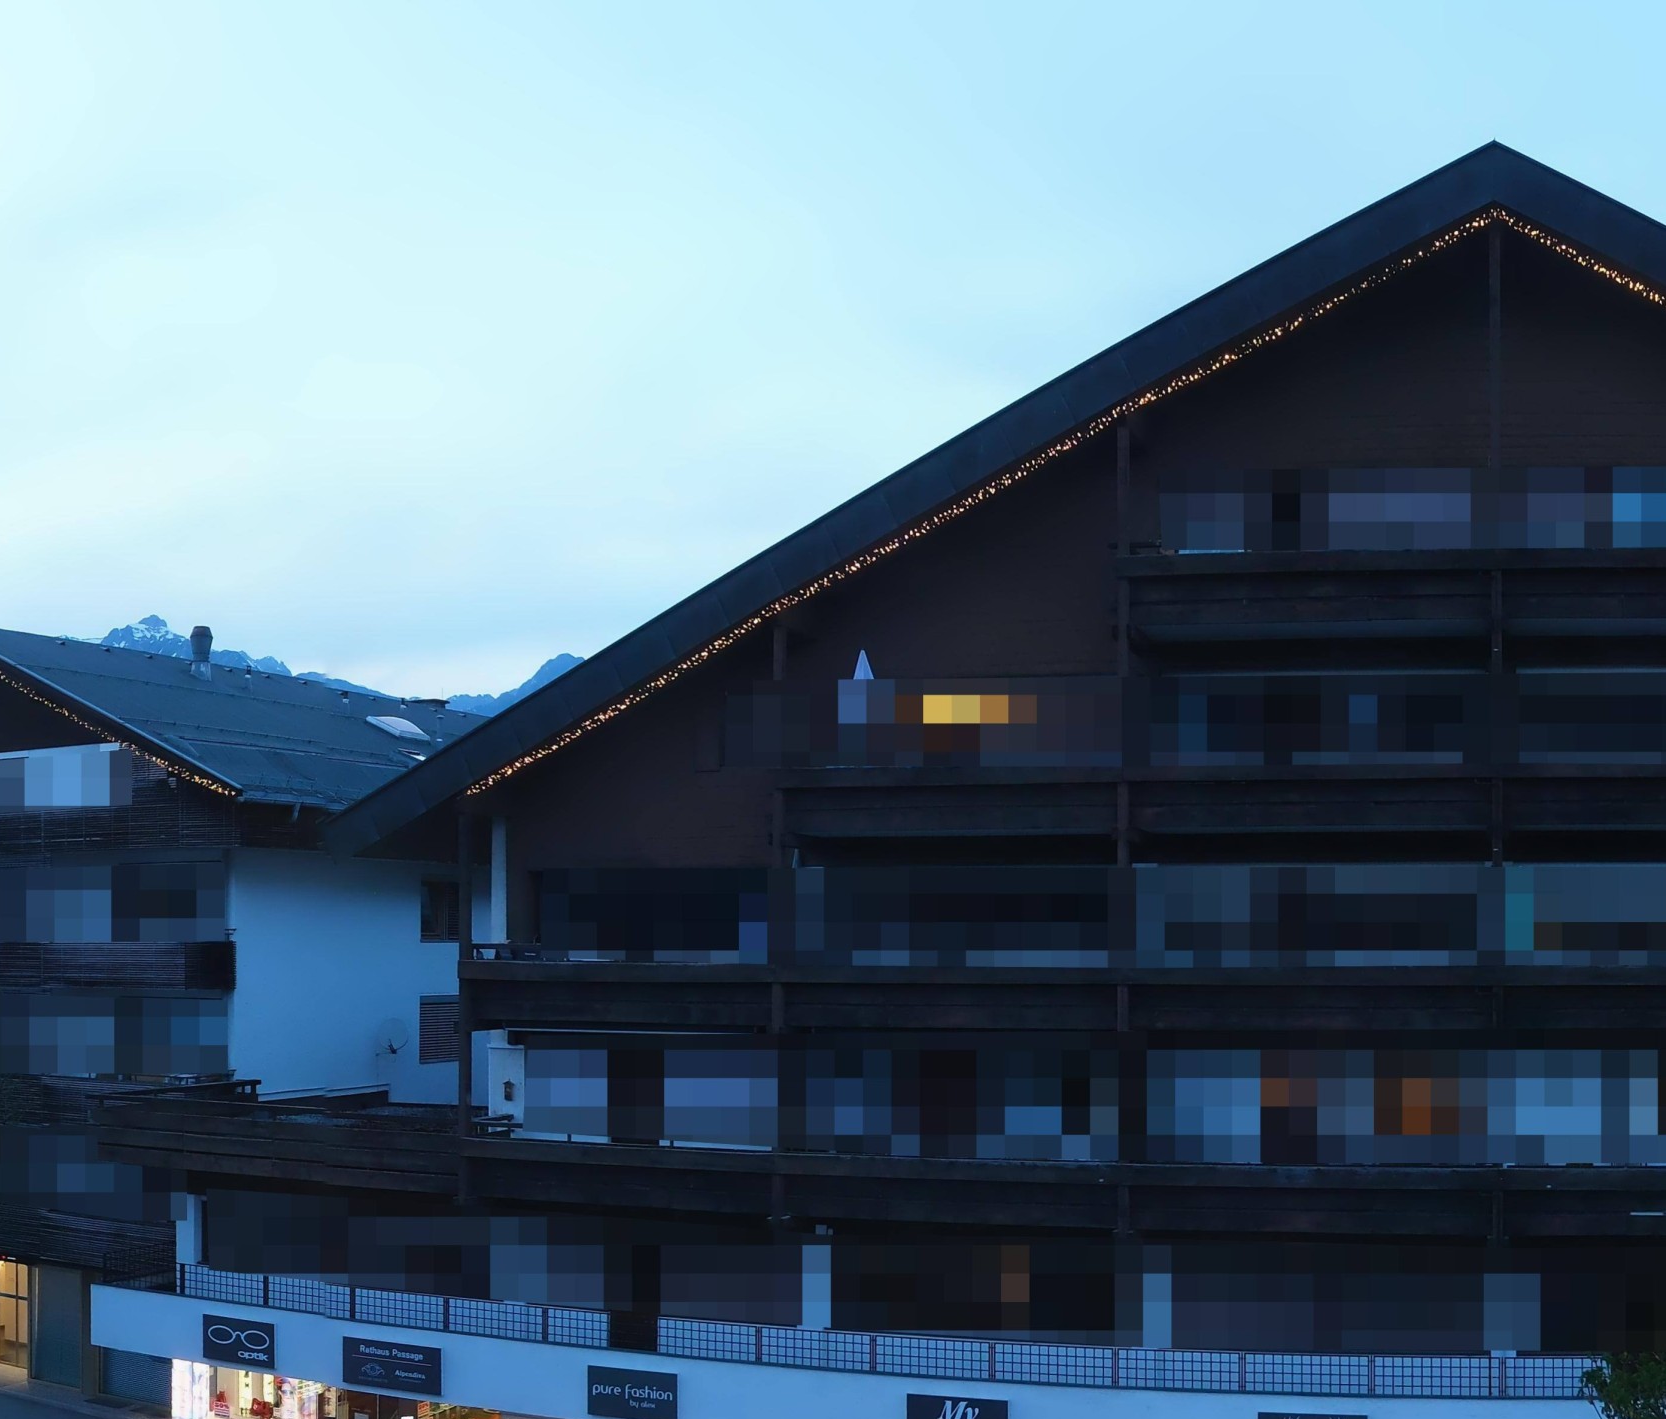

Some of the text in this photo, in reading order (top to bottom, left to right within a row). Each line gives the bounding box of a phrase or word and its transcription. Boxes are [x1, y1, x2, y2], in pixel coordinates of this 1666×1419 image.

[238, 1350, 268, 1362] optik
[360, 1345, 423, 1362] Rathaus Passage
[592, 1384, 673, 1400] pure fashion
